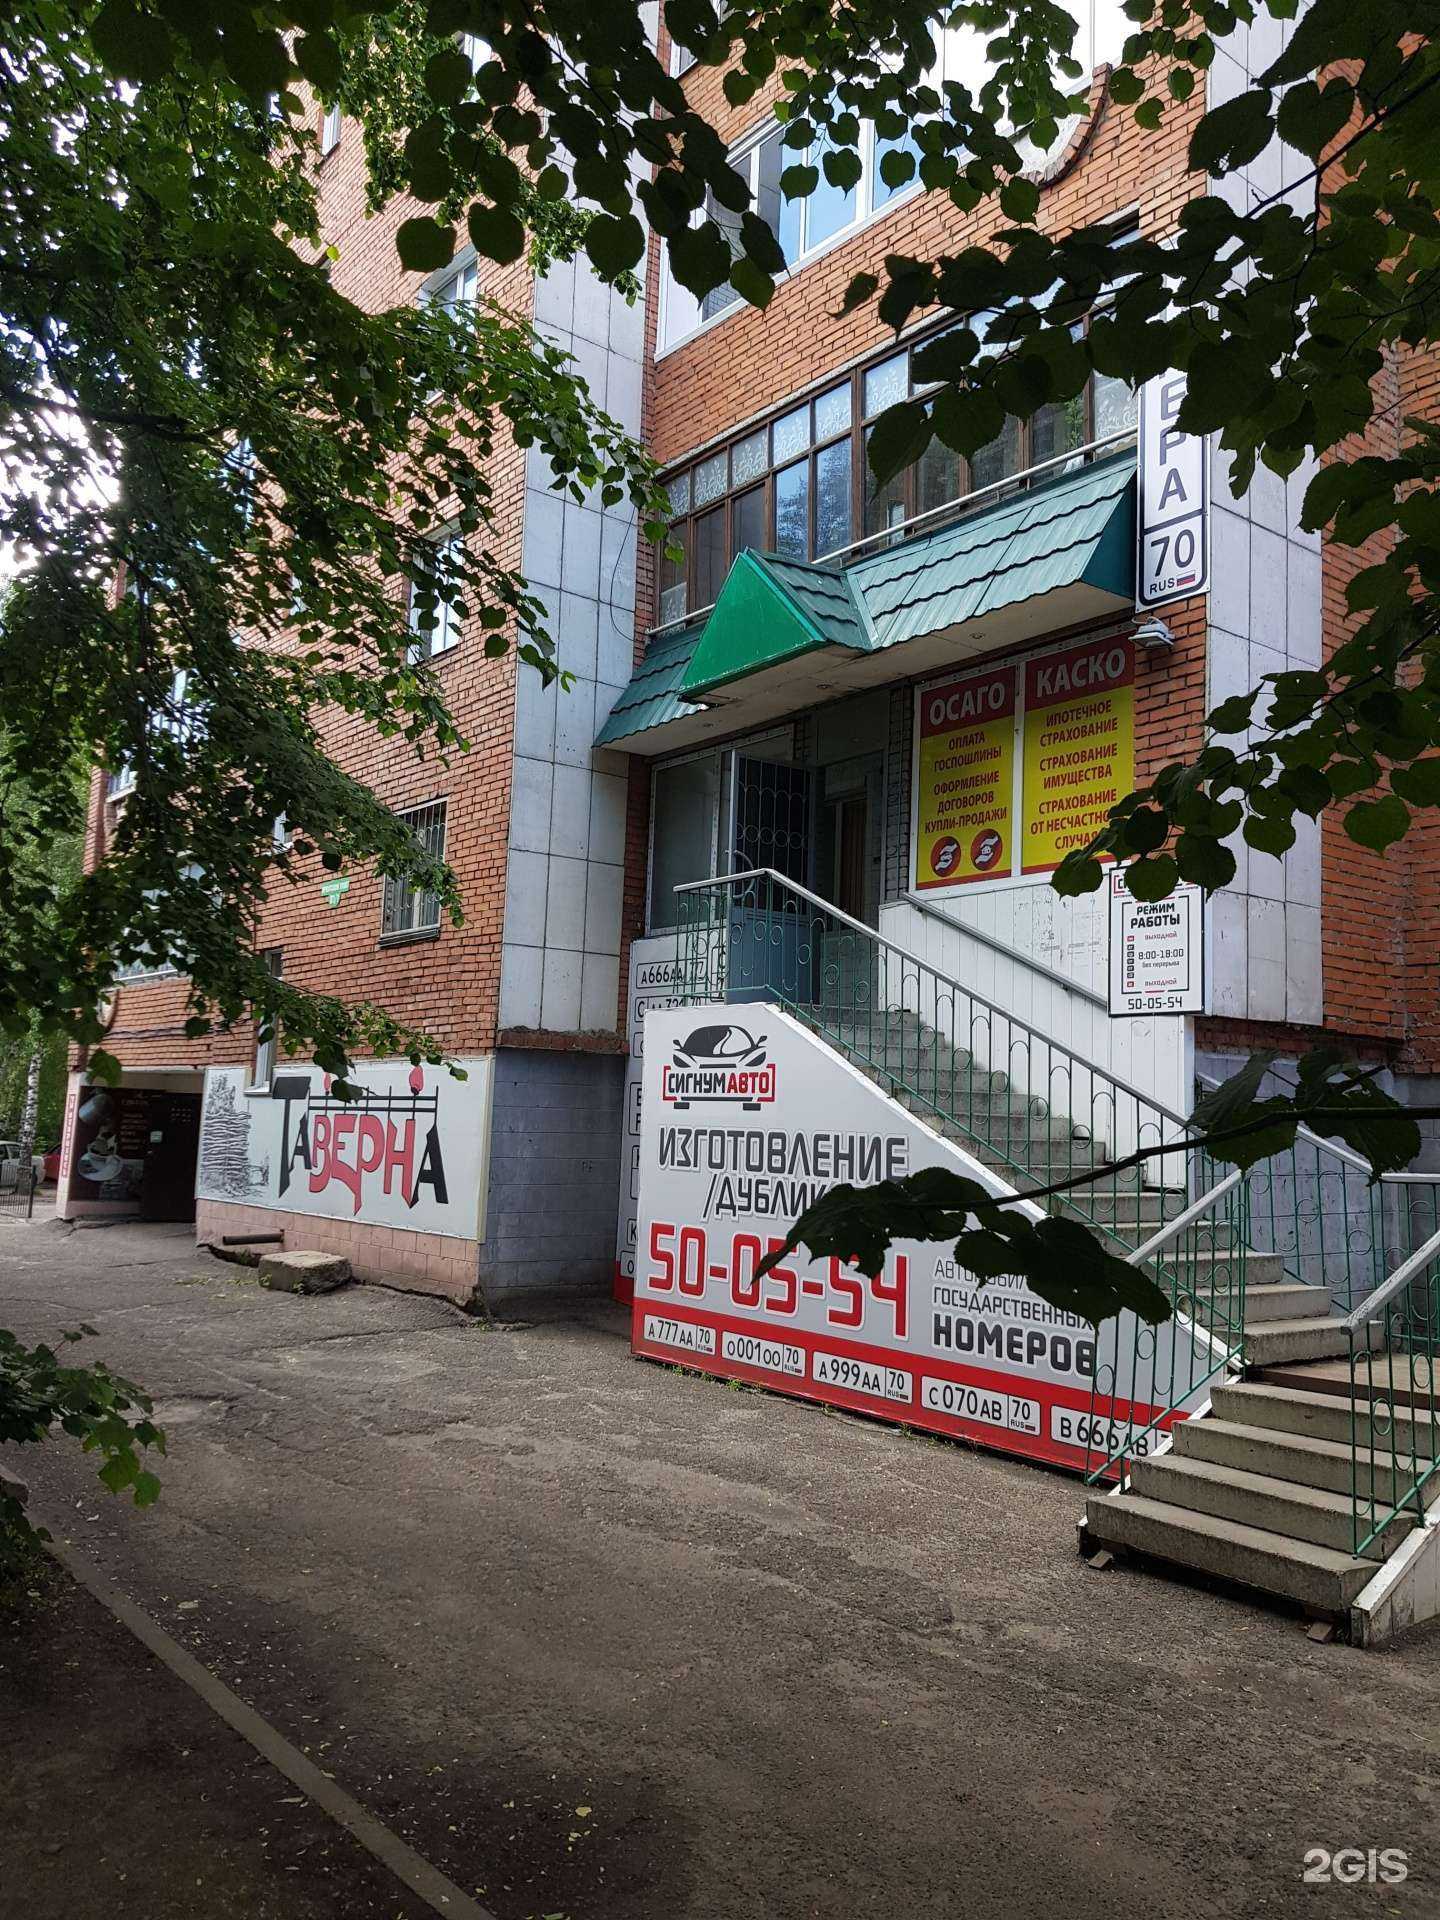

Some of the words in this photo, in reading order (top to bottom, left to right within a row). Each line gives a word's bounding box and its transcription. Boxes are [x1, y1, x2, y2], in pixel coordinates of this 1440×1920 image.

[1158, 374, 1188, 511] ЕРА
[1151, 529, 1195, 577] 70
[1150, 577, 1175, 594] RUS
[1036, 648, 1126, 698] КАСКО
[930, 683, 1005, 726] ОСАГО
[1046, 700, 1112, 728] ИПОТЕЧНОЕ
[949, 731, 985, 750] ОПЛАТА
[1040, 718, 1118, 747] СТРАХОВАНИЕ
[934, 746, 1002, 772] ГОСПОШЛИНЫ
[1040, 743, 1118, 772] СТРАХОВАНИЕ
[934, 771, 1000, 795] ОФОРМЛЕНИЕ
[1043, 764, 1112, 790] ИМУЩЕСТВА
[937, 791, 994, 816] ДОГОВОРОВ
[1039, 789, 1117, 815] СТРАХОВАНИЕ
[925, 807, 1007, 834] КУПЛИ-ПРОДАЖИ
[1031, 821, 1044, 835] ОТ
[1046, 809, 1109, 832] НЕСЧАСТНО
[1055, 833, 1098, 850] СЛУЧАЯ
[1131, 914, 1180, 929] РАБОТЫ
[1137, 903, 1175, 916] РЕЖИМ
[1138, 949, 1184, 960] 8:00-18:00
[1128, 996, 1183, 1010] 50-05-54
[272, 1077, 449, 1216] ТАВЕРНА
[659, 1128, 906, 1181] ИЗГОТОВЛЕНИЕ
[703, 1174, 827, 1218] /ДУБЛИК
[648, 1223, 907, 1337] 50-05-54
[698, 1328, 711, 1344] 70
[933, 1314, 1096, 1377] НОМЕРОВ
[786, 1348, 799, 1364] 70
[888, 1389, 899, 1398] RUS
[889, 1371, 904, 1390] 70
[1012, 1400, 1031, 1420] 70
[1010, 1419, 1024, 1429] RUS
